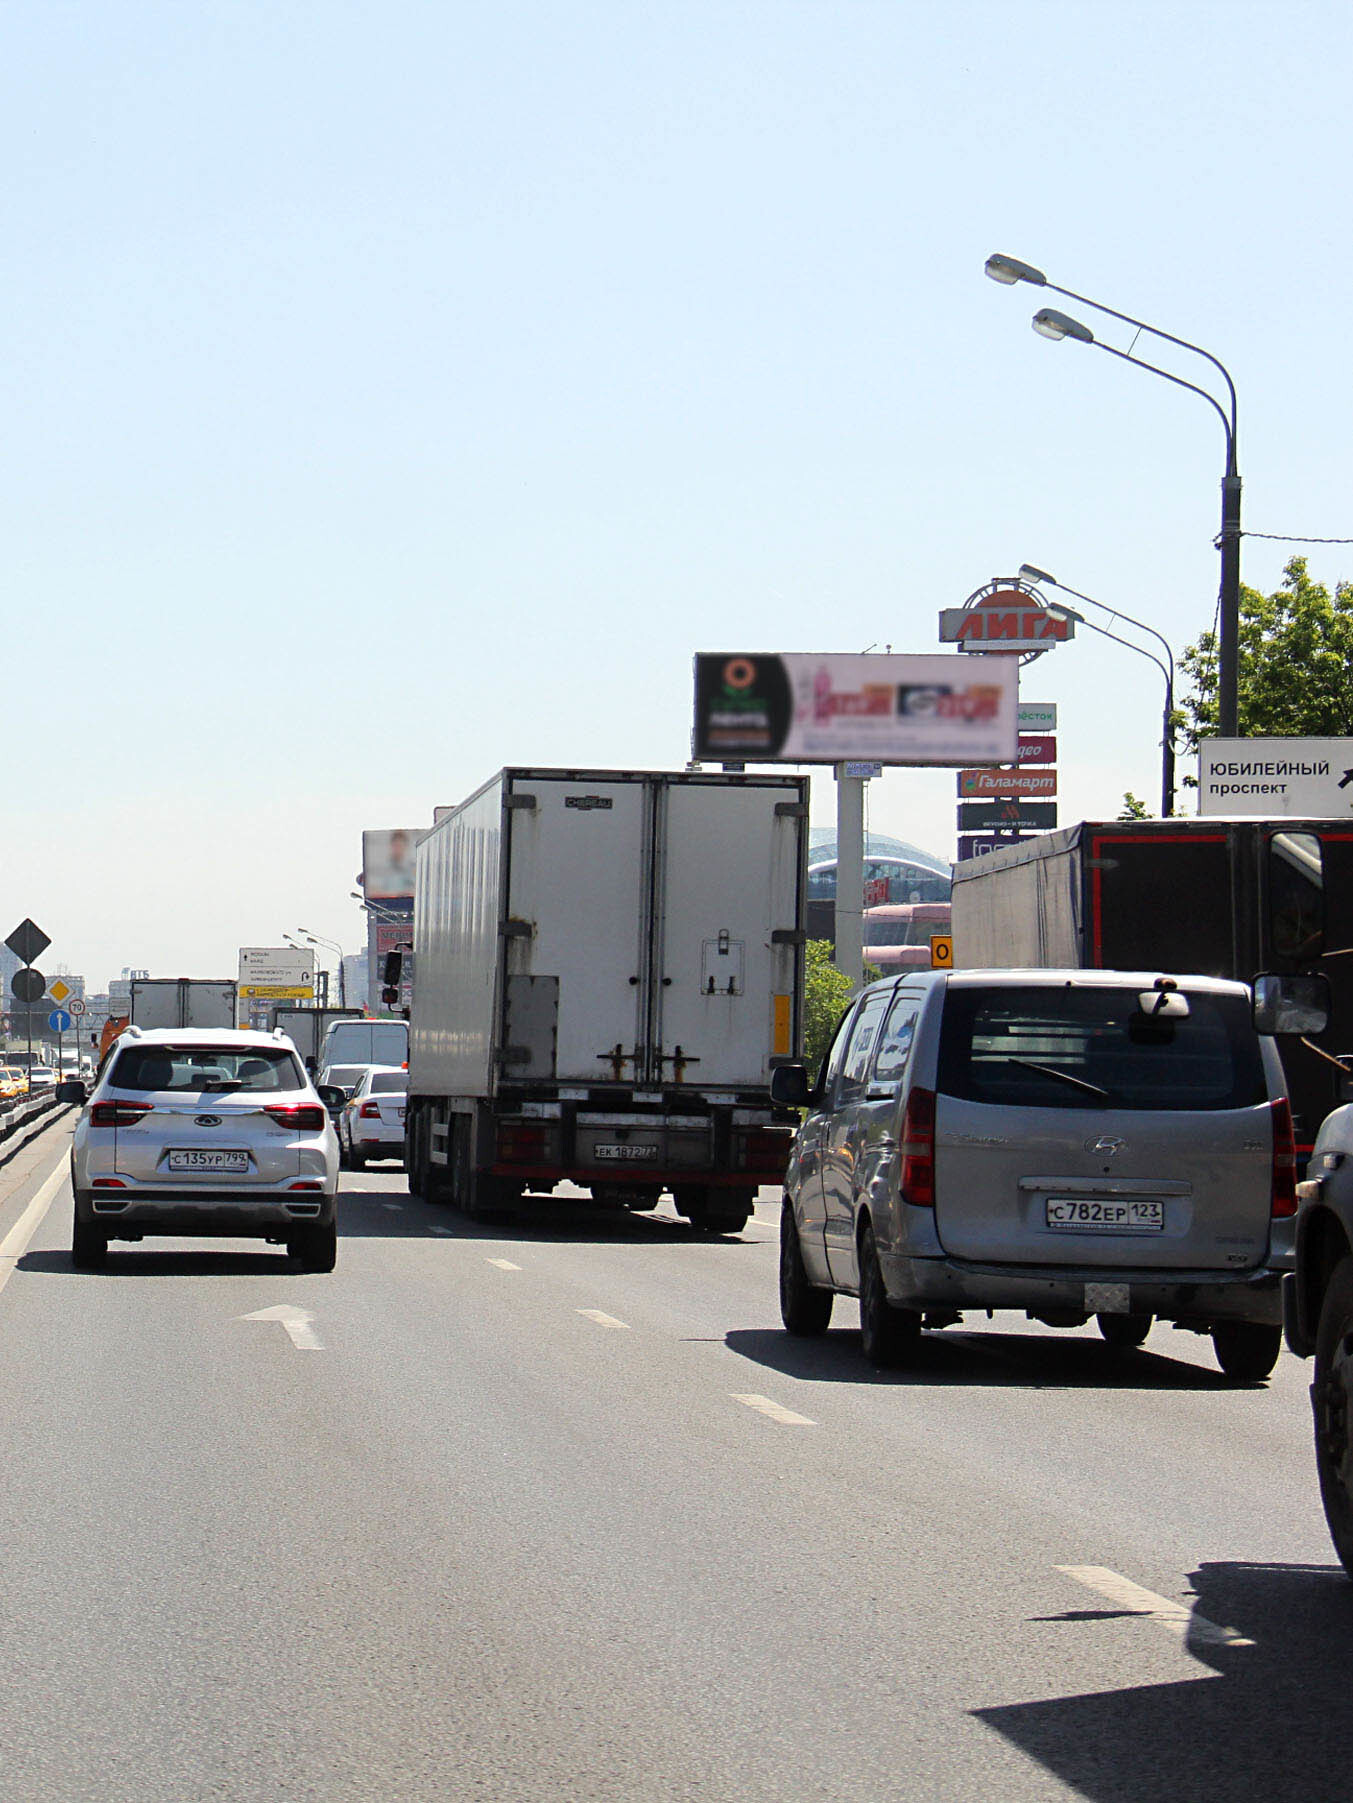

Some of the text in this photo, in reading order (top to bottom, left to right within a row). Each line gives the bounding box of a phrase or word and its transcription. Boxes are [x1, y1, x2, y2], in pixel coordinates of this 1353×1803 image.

[954, 612, 1068, 639] ЛИГА
[1210, 760, 1330, 776] ЮБИЛЕЙНЫЙ
[978, 775, 1055, 791] Галамарт
[1210, 783, 1288, 797] проспект
[130, 969, 150, 980] ВТБ
[72, 1004, 82, 1012] 70
[1054, 1203, 1126, 1220] С782ЕР
